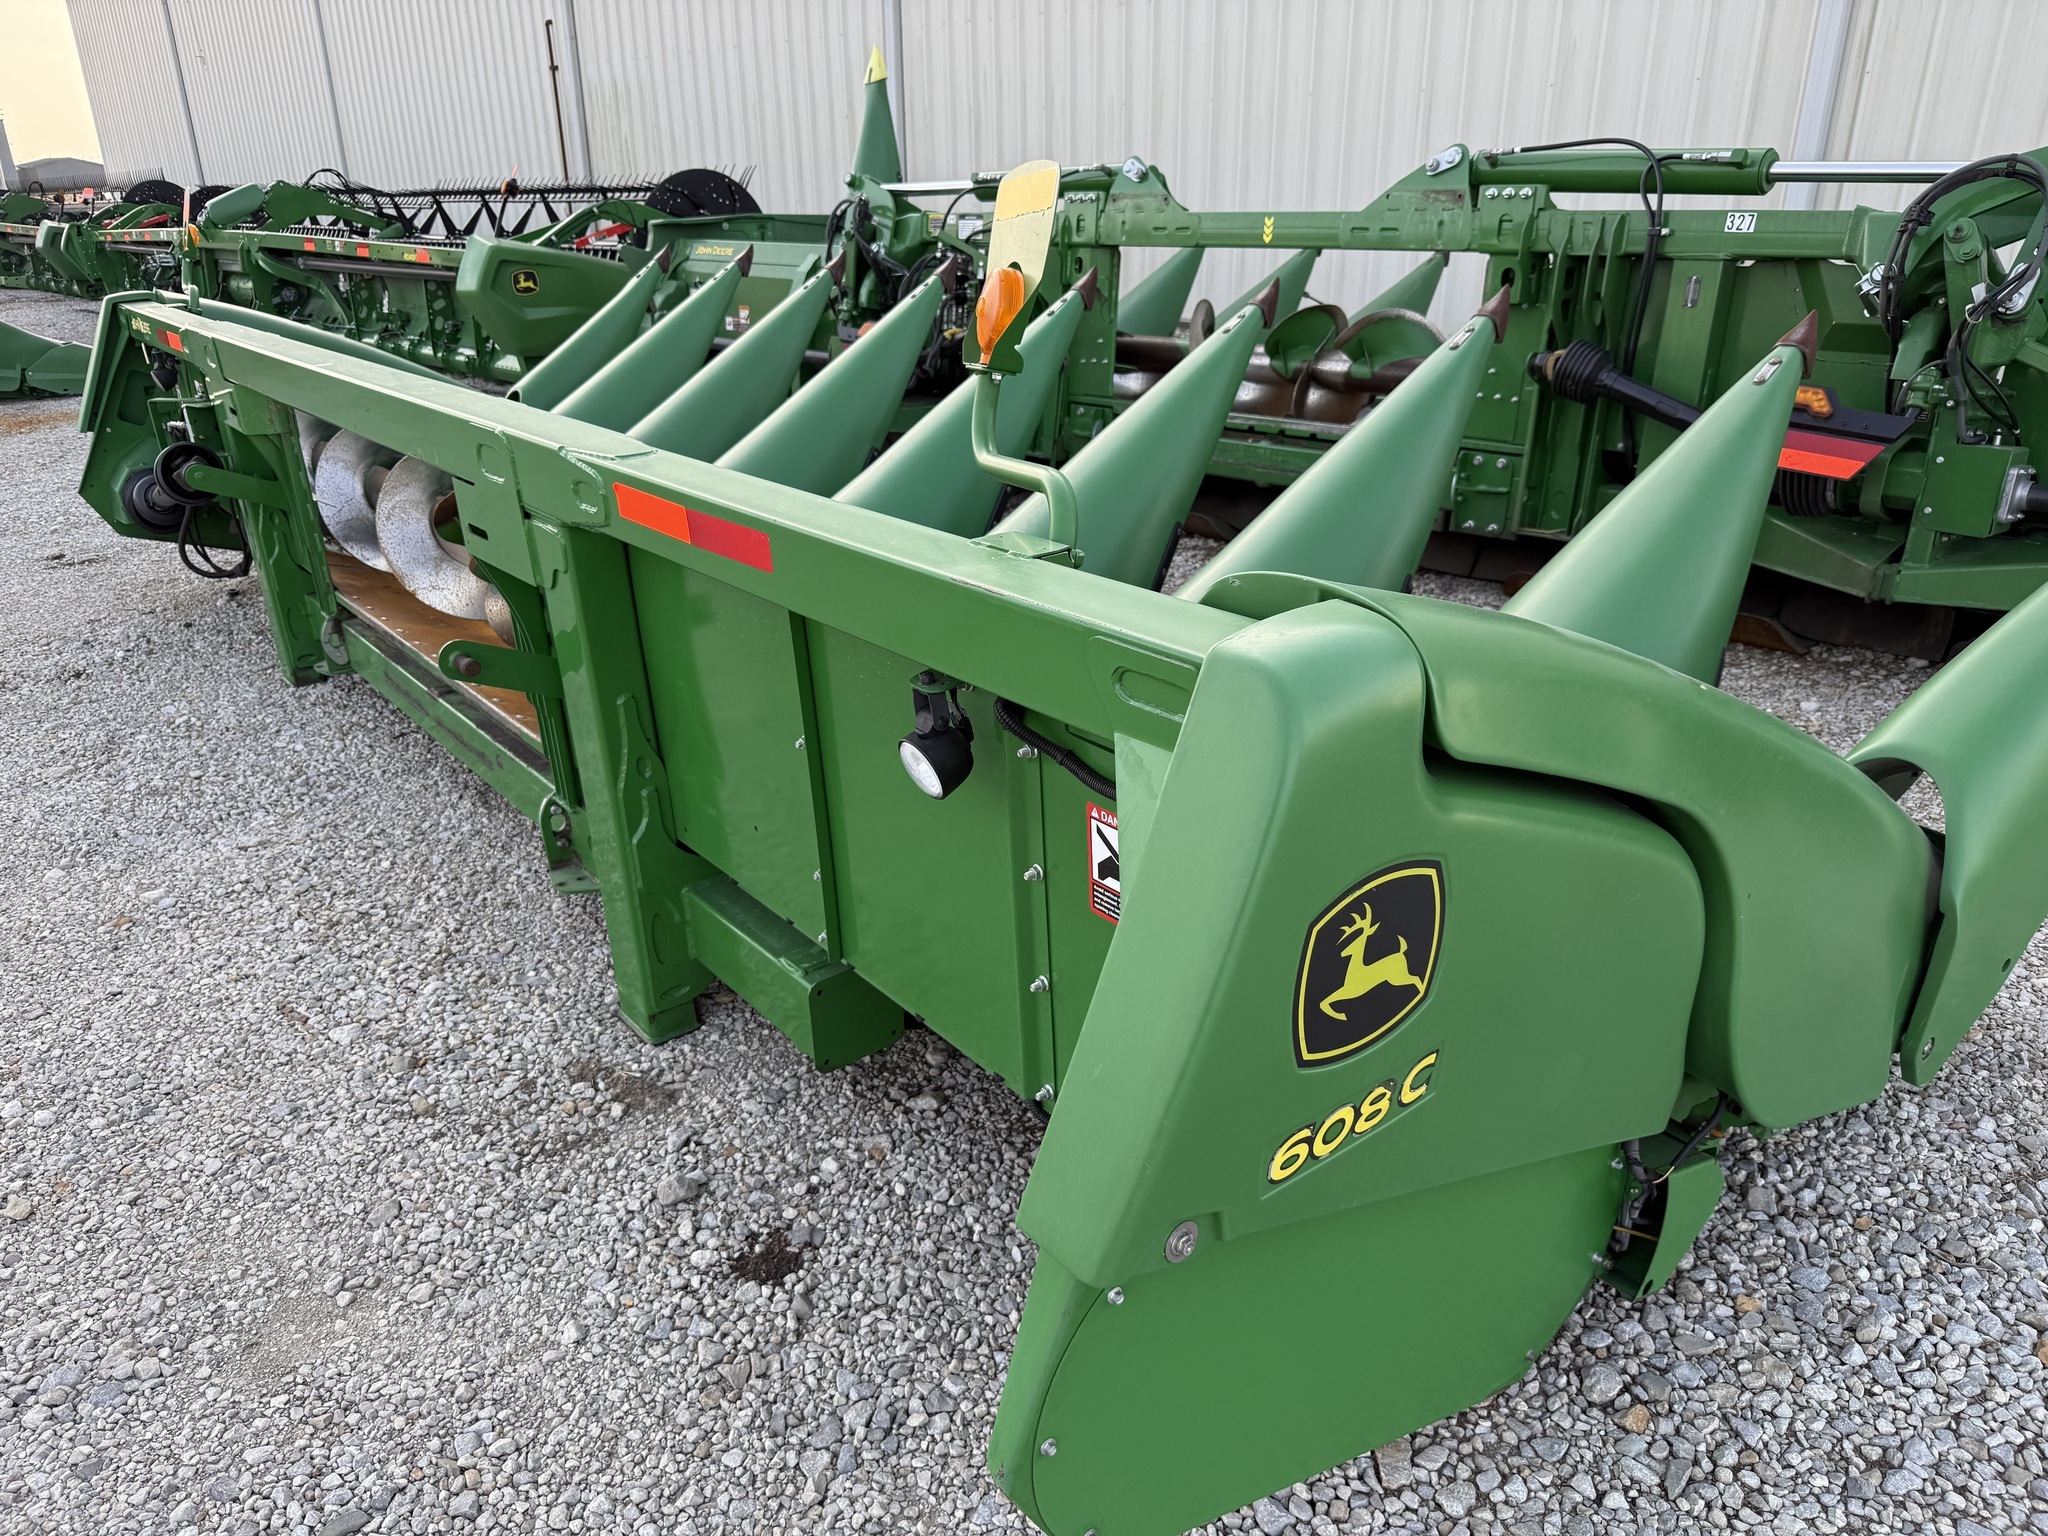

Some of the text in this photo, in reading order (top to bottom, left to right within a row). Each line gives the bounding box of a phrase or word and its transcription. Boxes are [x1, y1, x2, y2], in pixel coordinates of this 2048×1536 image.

[1727, 214, 1755, 231] 327
[695, 245, 734, 256] JOHN DEERE
[1101, 810, 1118, 827] DAN
